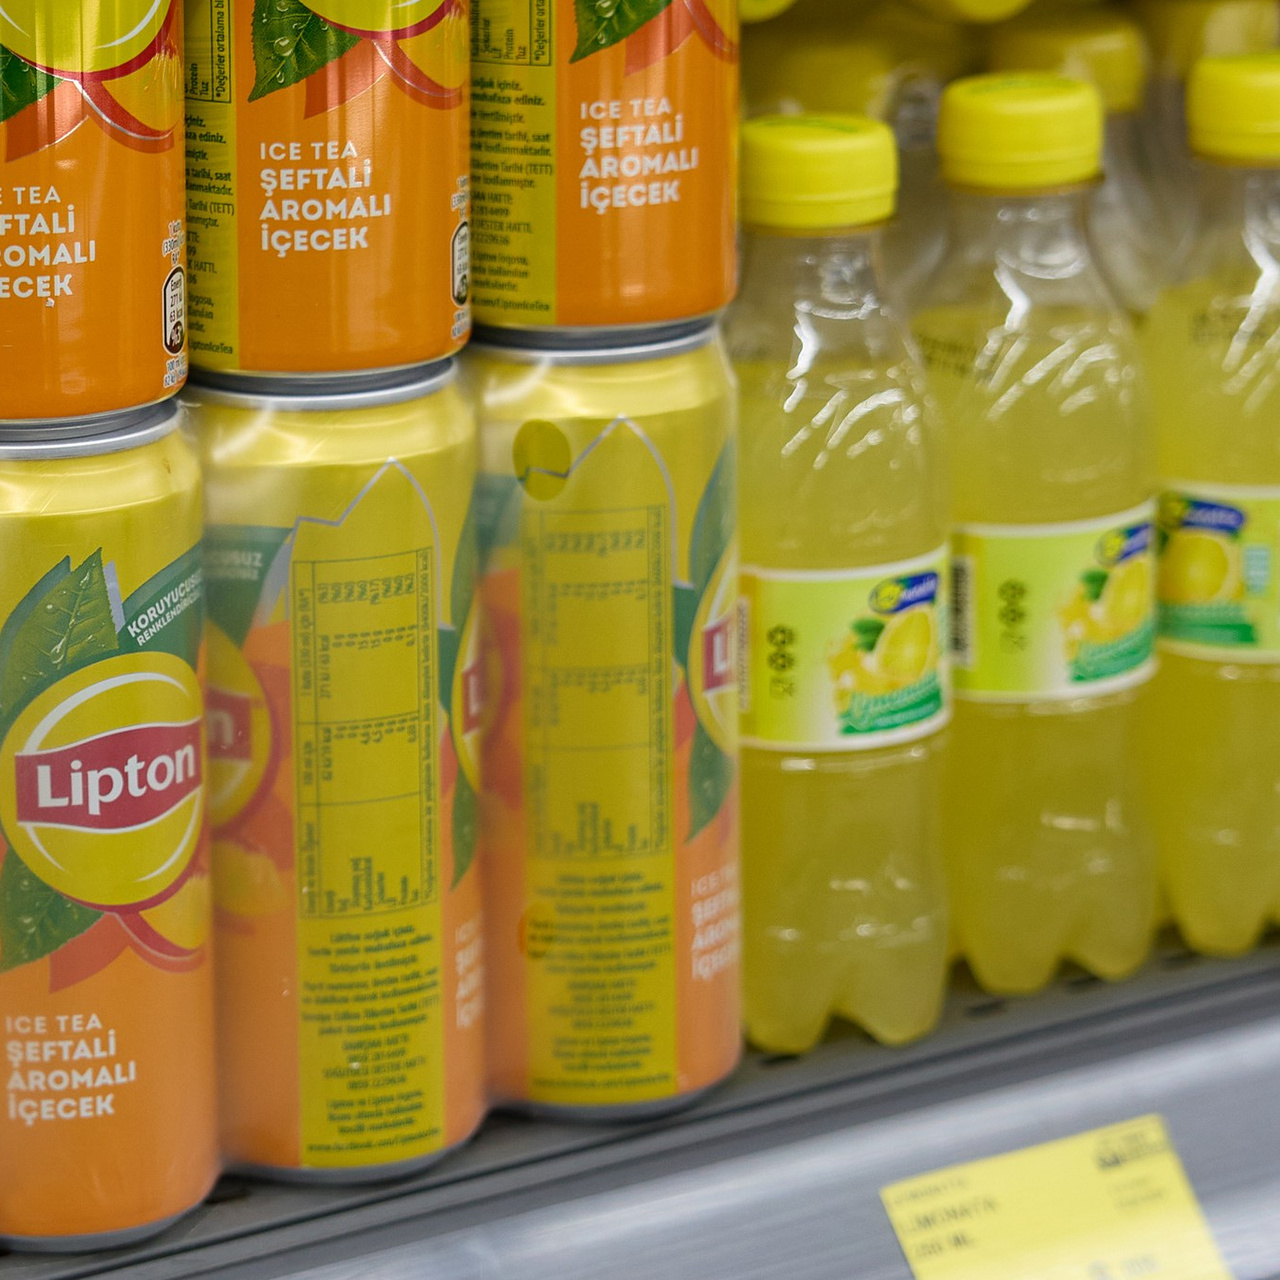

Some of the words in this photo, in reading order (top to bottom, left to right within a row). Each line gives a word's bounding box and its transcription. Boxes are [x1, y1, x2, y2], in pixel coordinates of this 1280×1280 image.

[580, 100, 622, 120] ICE
[629, 97, 672, 117] TEA
[259, 142, 302, 161] ICE
[310, 140, 359, 159] TEA
[579, 114, 684, 156] ŞEFTALİ
[260, 158, 372, 197] ŞEFTALİ
[579, 146, 699, 179] AROMALI
[12, 185, 61, 204] TEA
[260, 193, 391, 222] AROMALI
[580, 180, 680, 214] İÇECEK
[261, 225, 370, 258] İÇECEK
[36, 744, 196, 816] Lipton
[5, 1015, 48, 1036] ICE
[56, 1012, 104, 1034] TEA
[5, 1028, 117, 1069] ŞEFTALİ
[6, 1059, 138, 1093] AROMALI
[8, 1091, 116, 1128] İÇECEK
